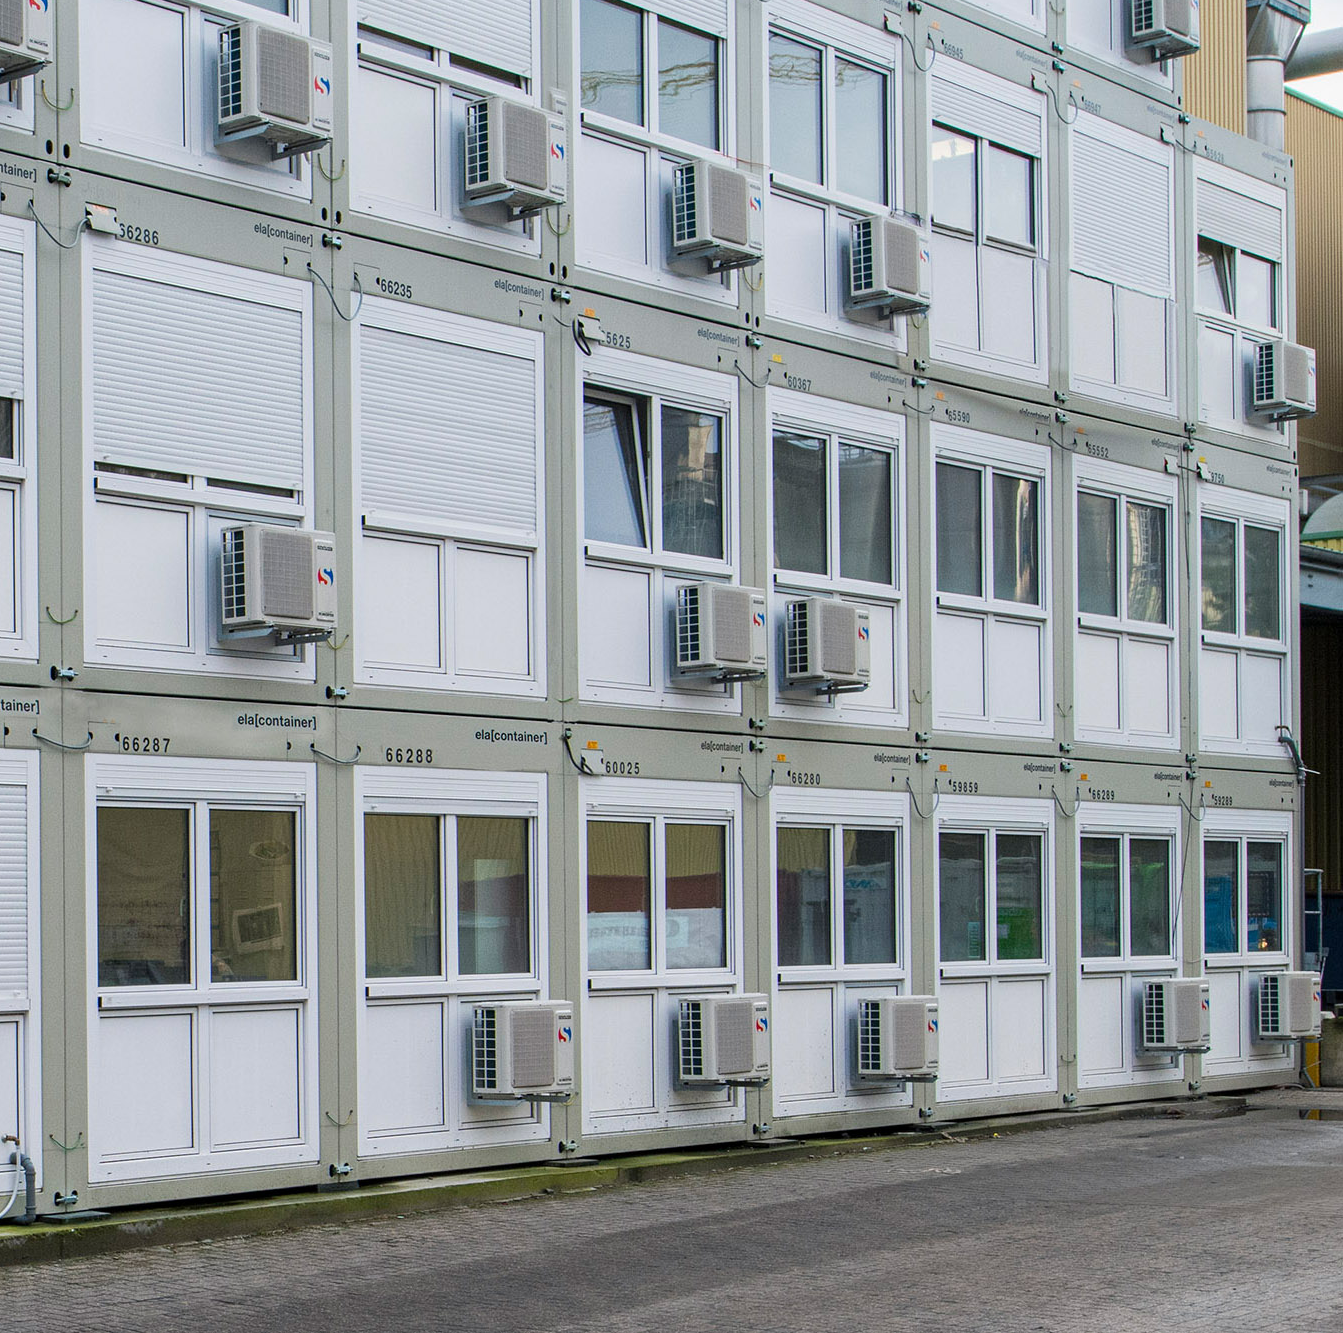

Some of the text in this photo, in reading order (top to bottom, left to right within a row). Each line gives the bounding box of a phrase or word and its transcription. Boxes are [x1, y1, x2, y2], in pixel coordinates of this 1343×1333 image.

[254, 223, 313, 247] ela[container]
[380, 279, 412, 299] 66235
[494, 279, 545, 301] ela[container]
[605, 331, 631, 349] 5625
[697, 328, 740, 347] ela[container]
[787, 376, 812, 392] 60367
[1207, 471, 1225, 484] 9750
[237, 714, 317, 730] ela[container]
[122, 736, 171, 753] 66287
[475, 729, 548, 745] ela[container]
[385, 748, 433, 763] 66288
[701, 741, 744, 754] ela[container]
[874, 753, 911, 765] ela[container]
[605, 761, 640, 775] 60025
[791, 772, 821, 785] 66280
[952, 781, 978, 793] 59859
[1092, 789, 1115, 800] 66289
